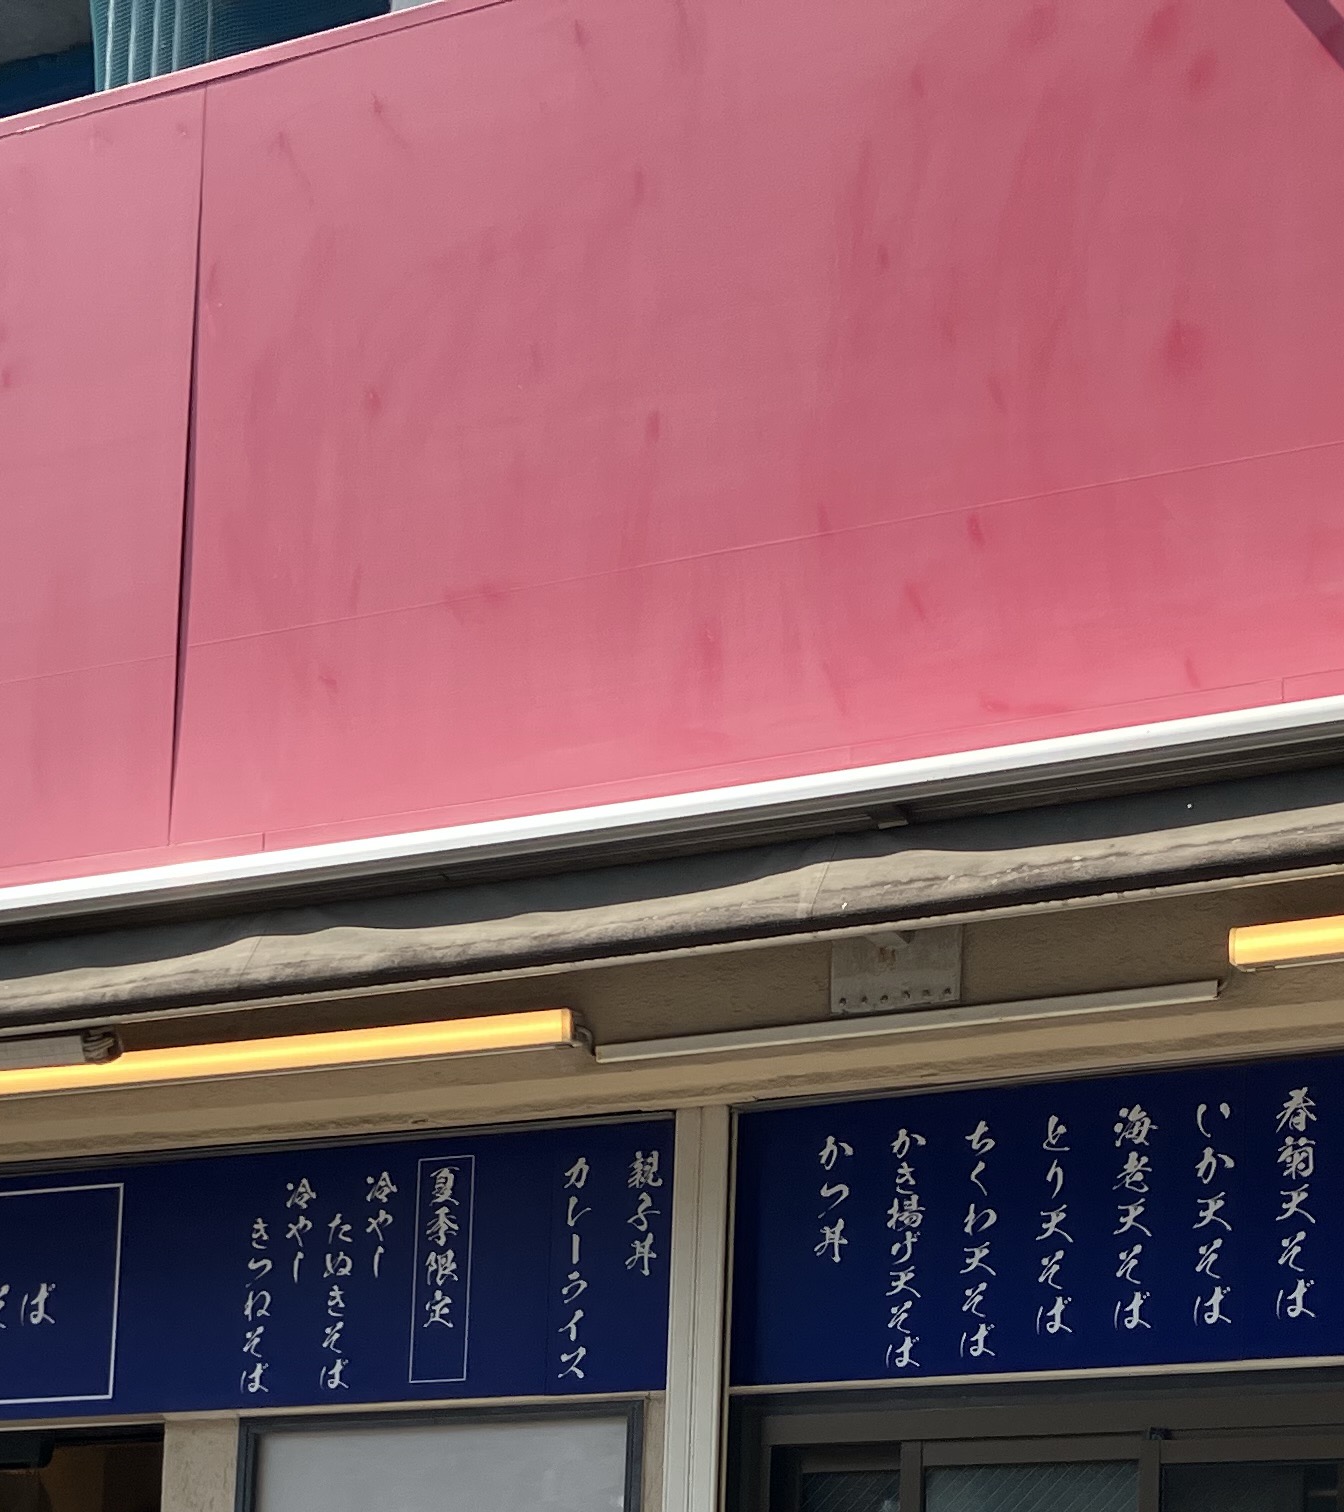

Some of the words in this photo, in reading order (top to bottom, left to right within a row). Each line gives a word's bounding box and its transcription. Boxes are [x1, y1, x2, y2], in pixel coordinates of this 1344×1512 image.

[286, 1178, 316, 1283] 冷やし
[366, 1172, 397, 1278] 冷やし
[423, 1166, 459, 1328] 夏季限定
[558, 1158, 591, 1380] カレーライス
[625, 1150, 663, 1277] 親子丼
[814, 1136, 853, 1262] かつ丼
[886, 1129, 926, 1367] かき揚げ天そば
[960, 1121, 997, 1356] ちくわ天そば
[1036, 1115, 1073, 1333] とり天そば
[1113, 1104, 1157, 1329] 海老天そば
[1193, 1103, 1234, 1324] いか天そば
[1276, 1087, 1317, 1317] 春菊天そば
[241, 1218, 272, 1393] きつねそば
[320, 1213, 353, 1390] たぬきそば
